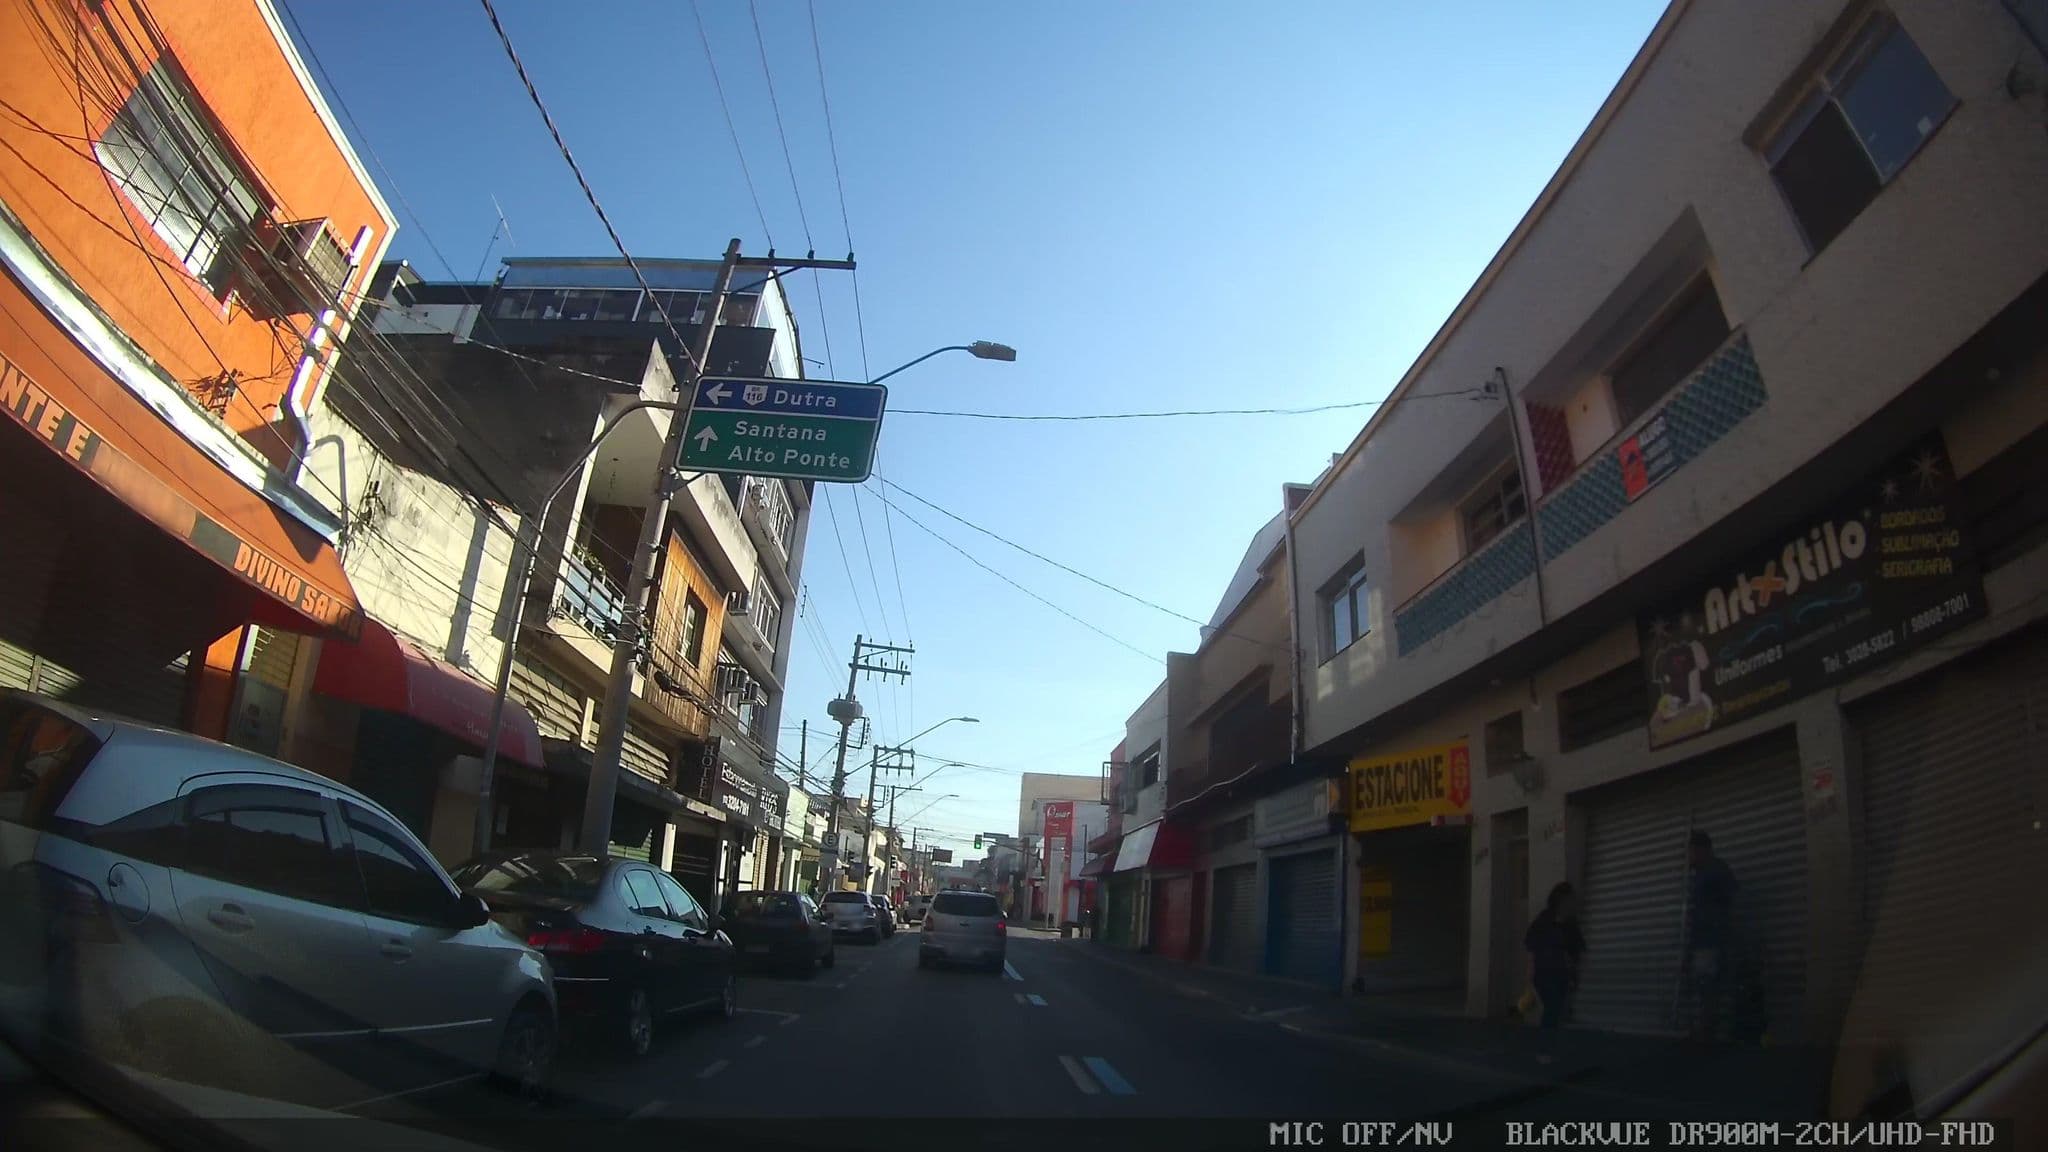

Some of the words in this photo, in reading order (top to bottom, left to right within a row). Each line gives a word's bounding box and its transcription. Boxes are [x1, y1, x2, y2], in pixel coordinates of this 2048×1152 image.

[0, 356, 65, 441] NTE
[65, 421, 92, 461] E
[774, 390, 837, 407] Dutra
[734, 420, 827, 441] Santana
[728, 446, 776, 463] Alto
[783, 449, 850, 469] Ponte
[234, 542, 301, 603] DIVINO
[1714, 644, 1784, 685] Uniformes
[1355, 754, 1445, 809] ESTACIONE
